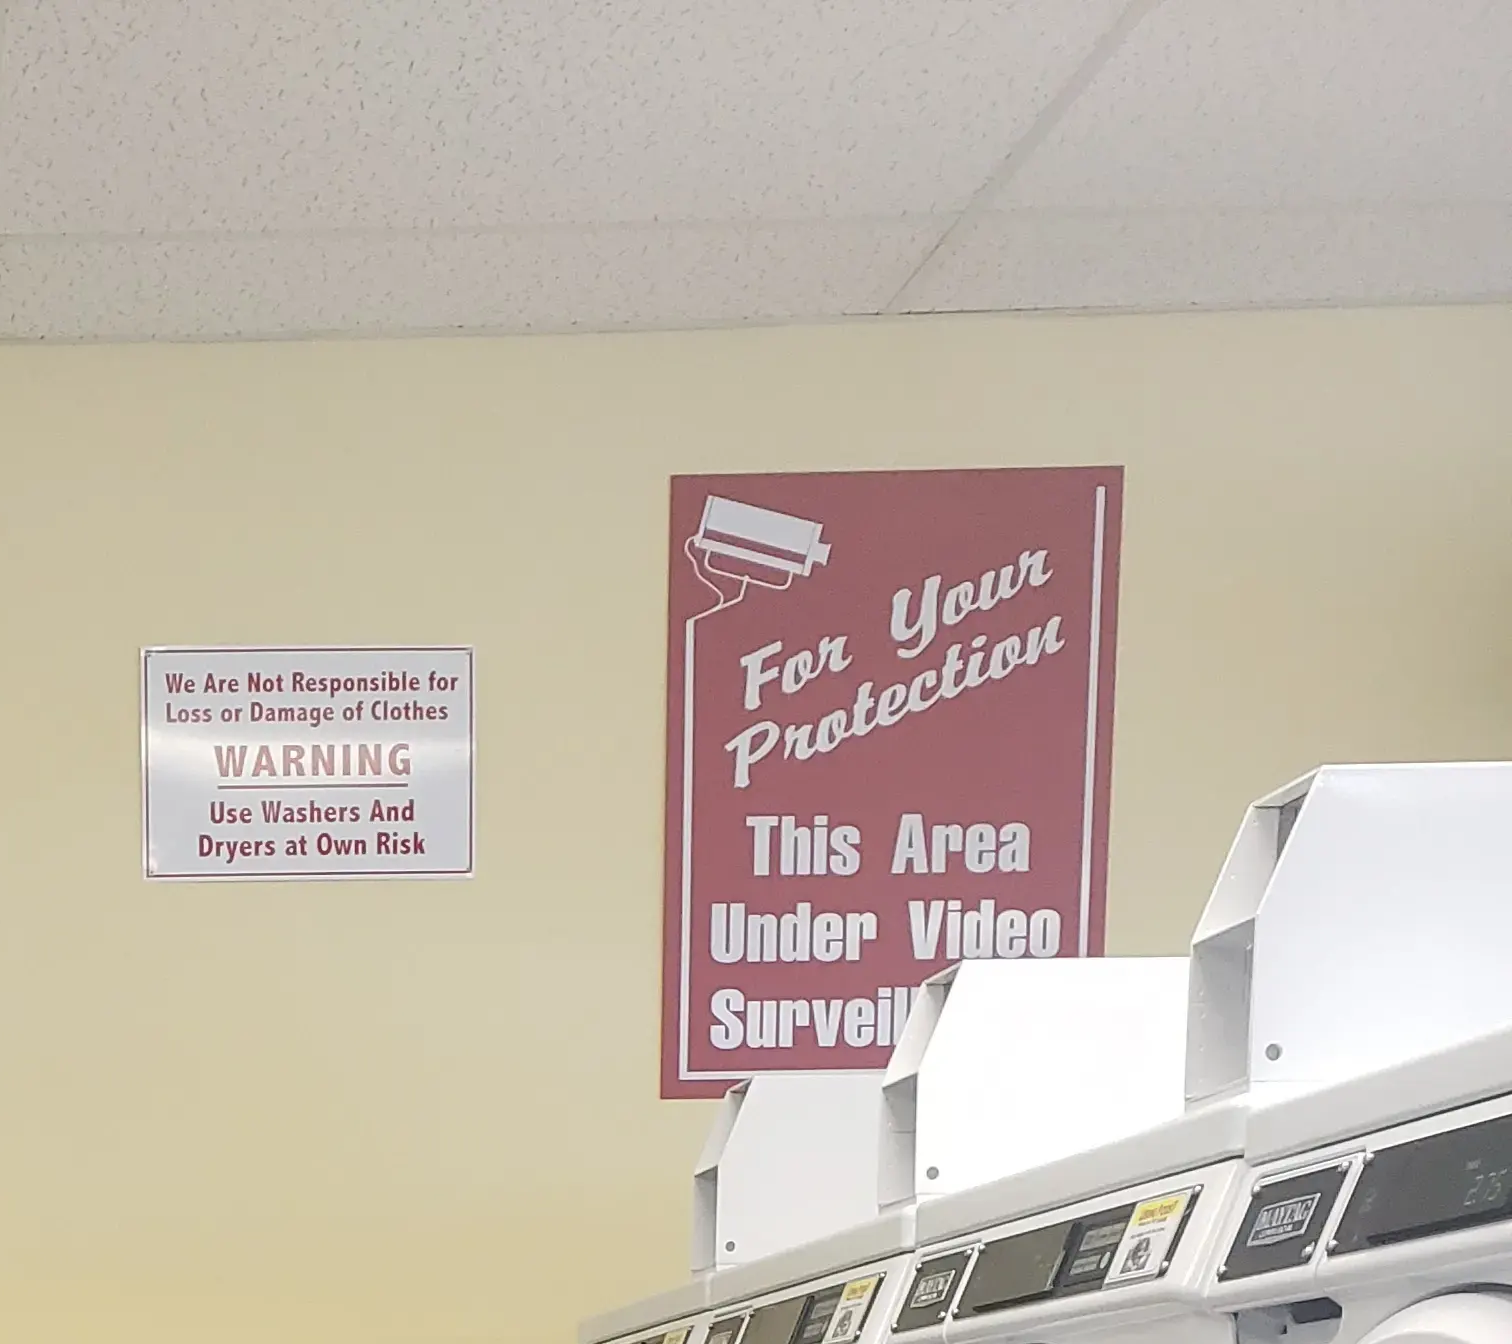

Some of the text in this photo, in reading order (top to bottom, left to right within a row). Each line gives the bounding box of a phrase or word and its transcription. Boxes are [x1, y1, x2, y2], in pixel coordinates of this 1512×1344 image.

[740, 547, 1054, 711] For Your
[165, 670, 458, 697] We Are Not Responsible for
[724, 615, 1066, 788] Protection
[166, 700, 449, 728] Loss or Damage of Clothes
[213, 742, 411, 777] WARNING
[210, 799, 415, 824] Use Washers And
[198, 831, 425, 864] Dryers at Own Risk
[745, 813, 1031, 877] This Area
[710, 899, 1062, 964] Under Video
[709, 987, 922, 1050] Surveil
